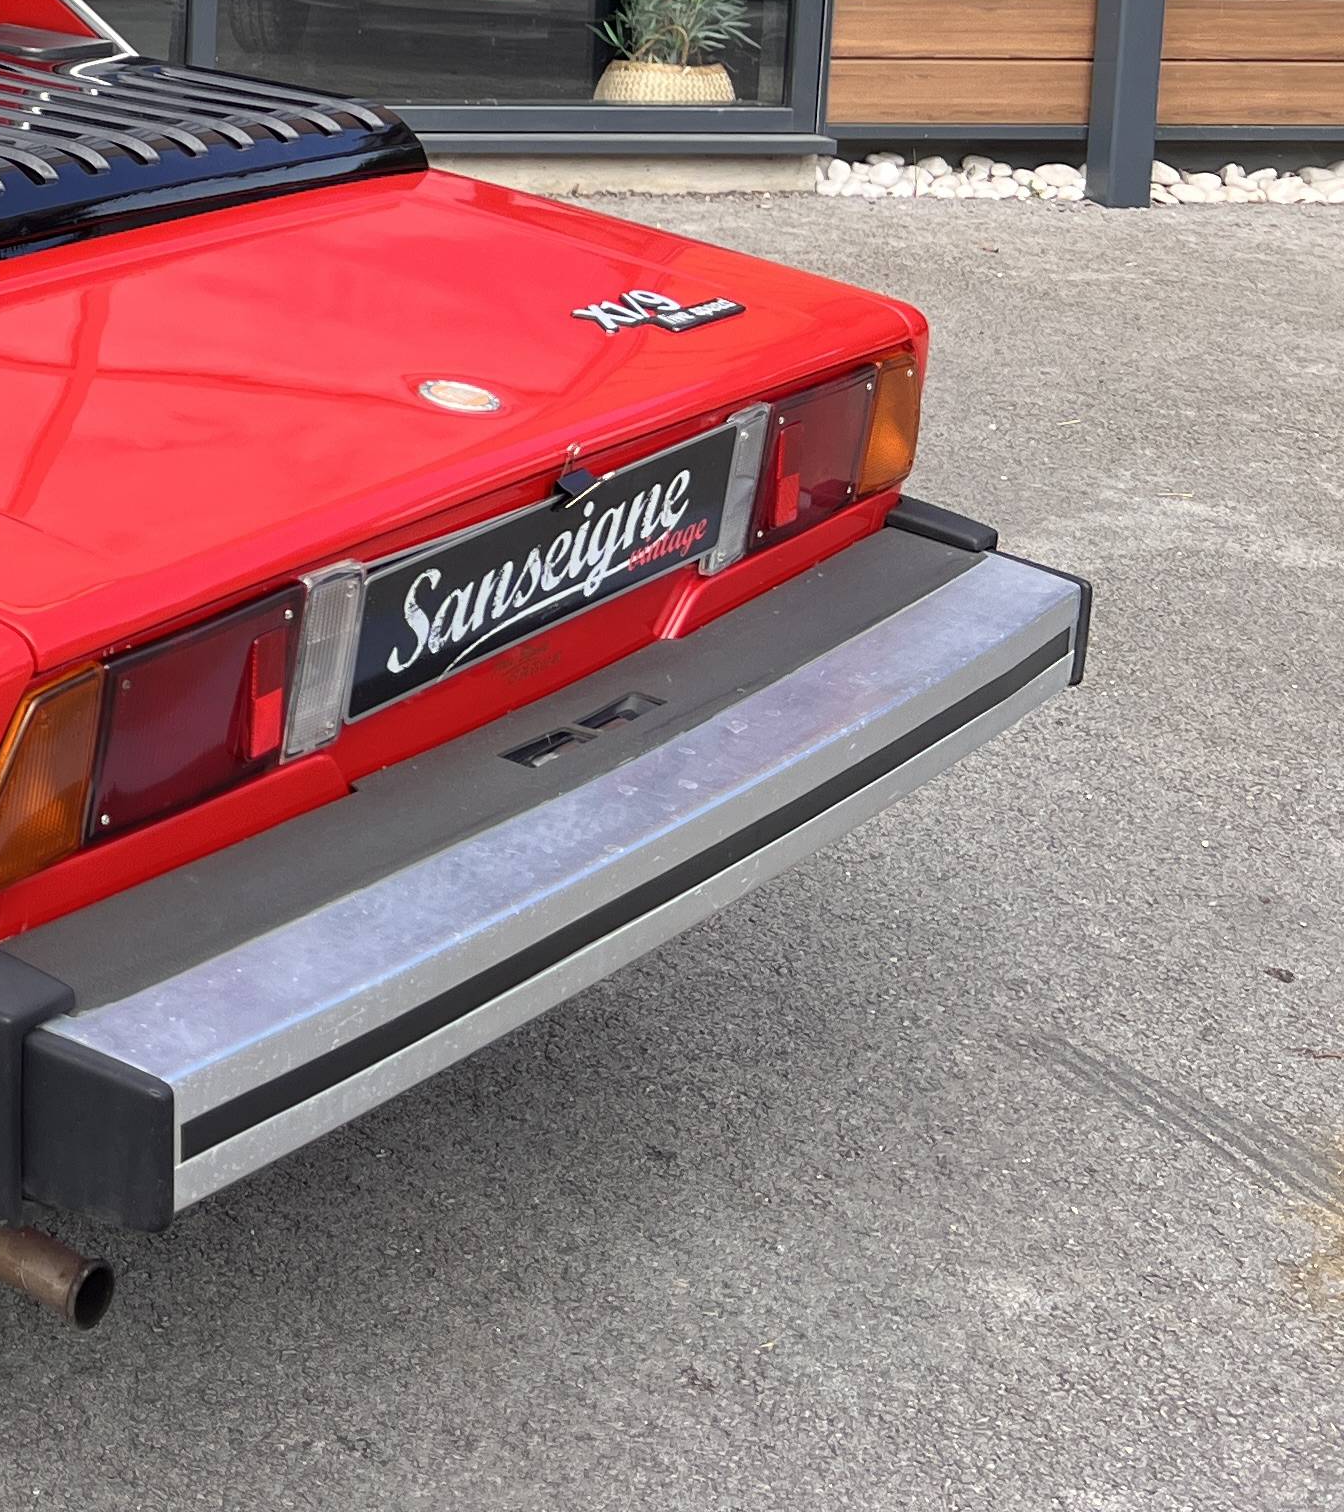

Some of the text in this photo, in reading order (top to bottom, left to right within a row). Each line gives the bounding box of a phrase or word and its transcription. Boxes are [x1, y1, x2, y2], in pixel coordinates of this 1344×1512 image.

[572, 289, 682, 334] X1/9
[386, 468, 691, 675] Sanseigne
[626, 516, 709, 573] vintage
